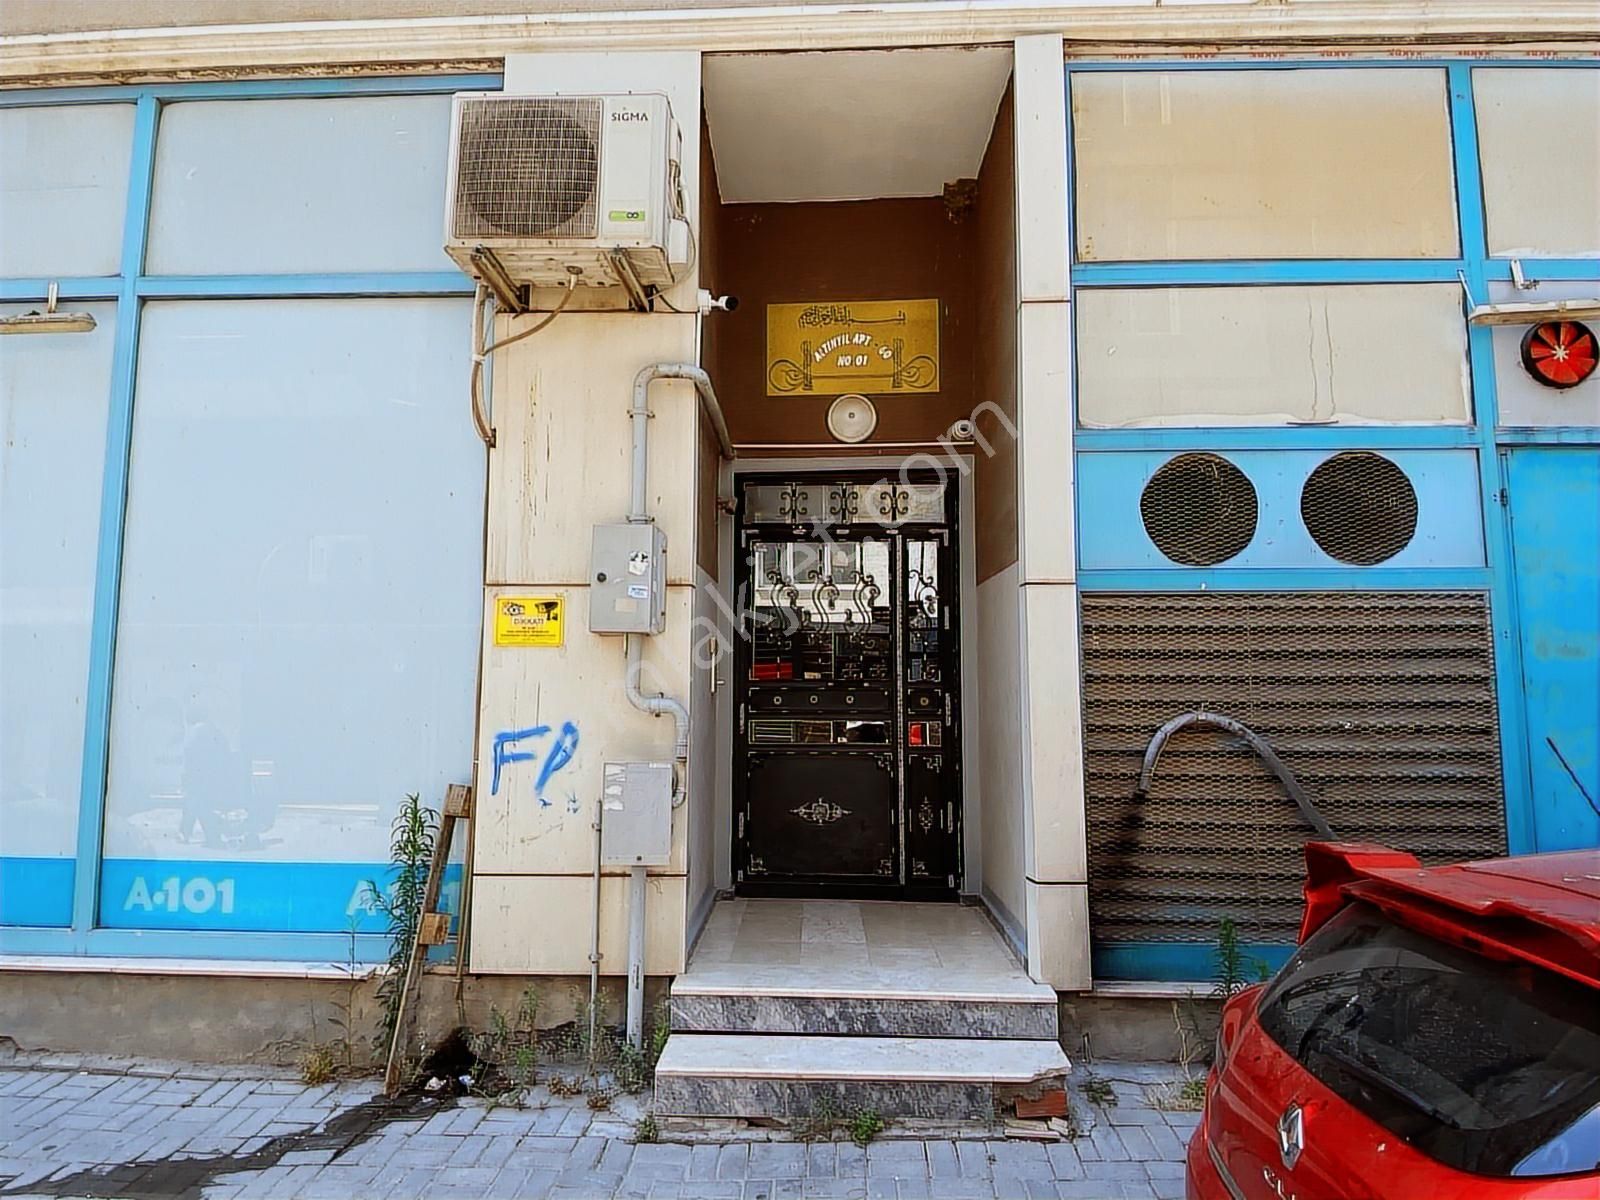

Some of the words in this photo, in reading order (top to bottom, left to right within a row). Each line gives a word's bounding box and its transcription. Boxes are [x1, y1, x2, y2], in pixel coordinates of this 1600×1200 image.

[611, 112, 648, 121] SIGMA
[852, 332, 872, 347] APT
[837, 355, 852, 366] NO
[1263, 1165, 1296, 1200] CL
